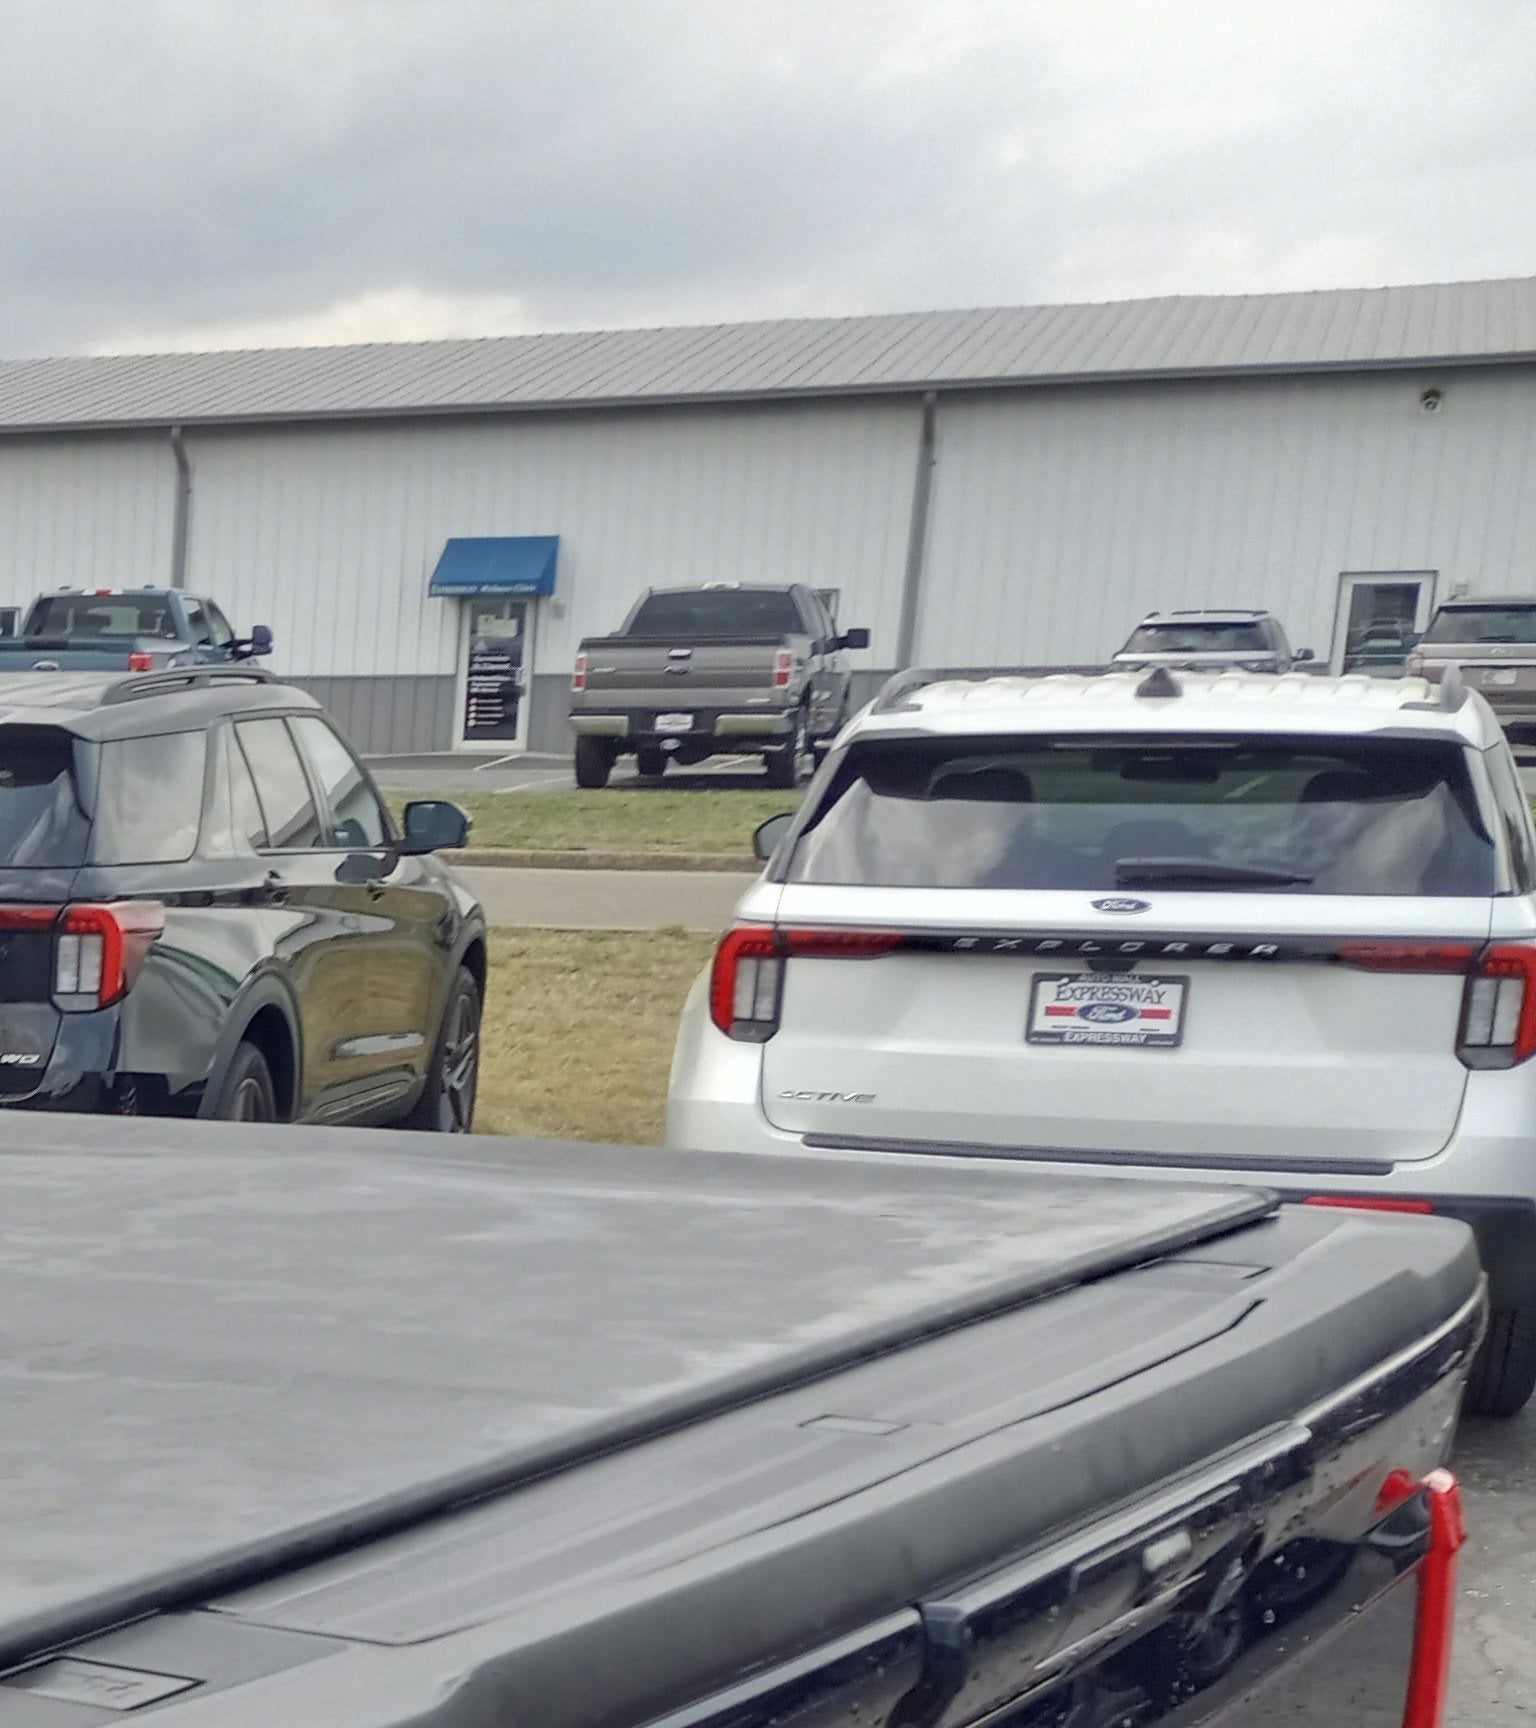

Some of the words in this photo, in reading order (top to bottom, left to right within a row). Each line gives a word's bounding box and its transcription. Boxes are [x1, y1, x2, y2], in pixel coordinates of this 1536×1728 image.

[953, 936, 1278, 956] EXPLORER
[1054, 985, 1168, 1004] EXPRESSWAY
[1086, 1005, 1129, 1021] Ford
[1062, 1031, 1148, 1045] EXPRESSWAY
